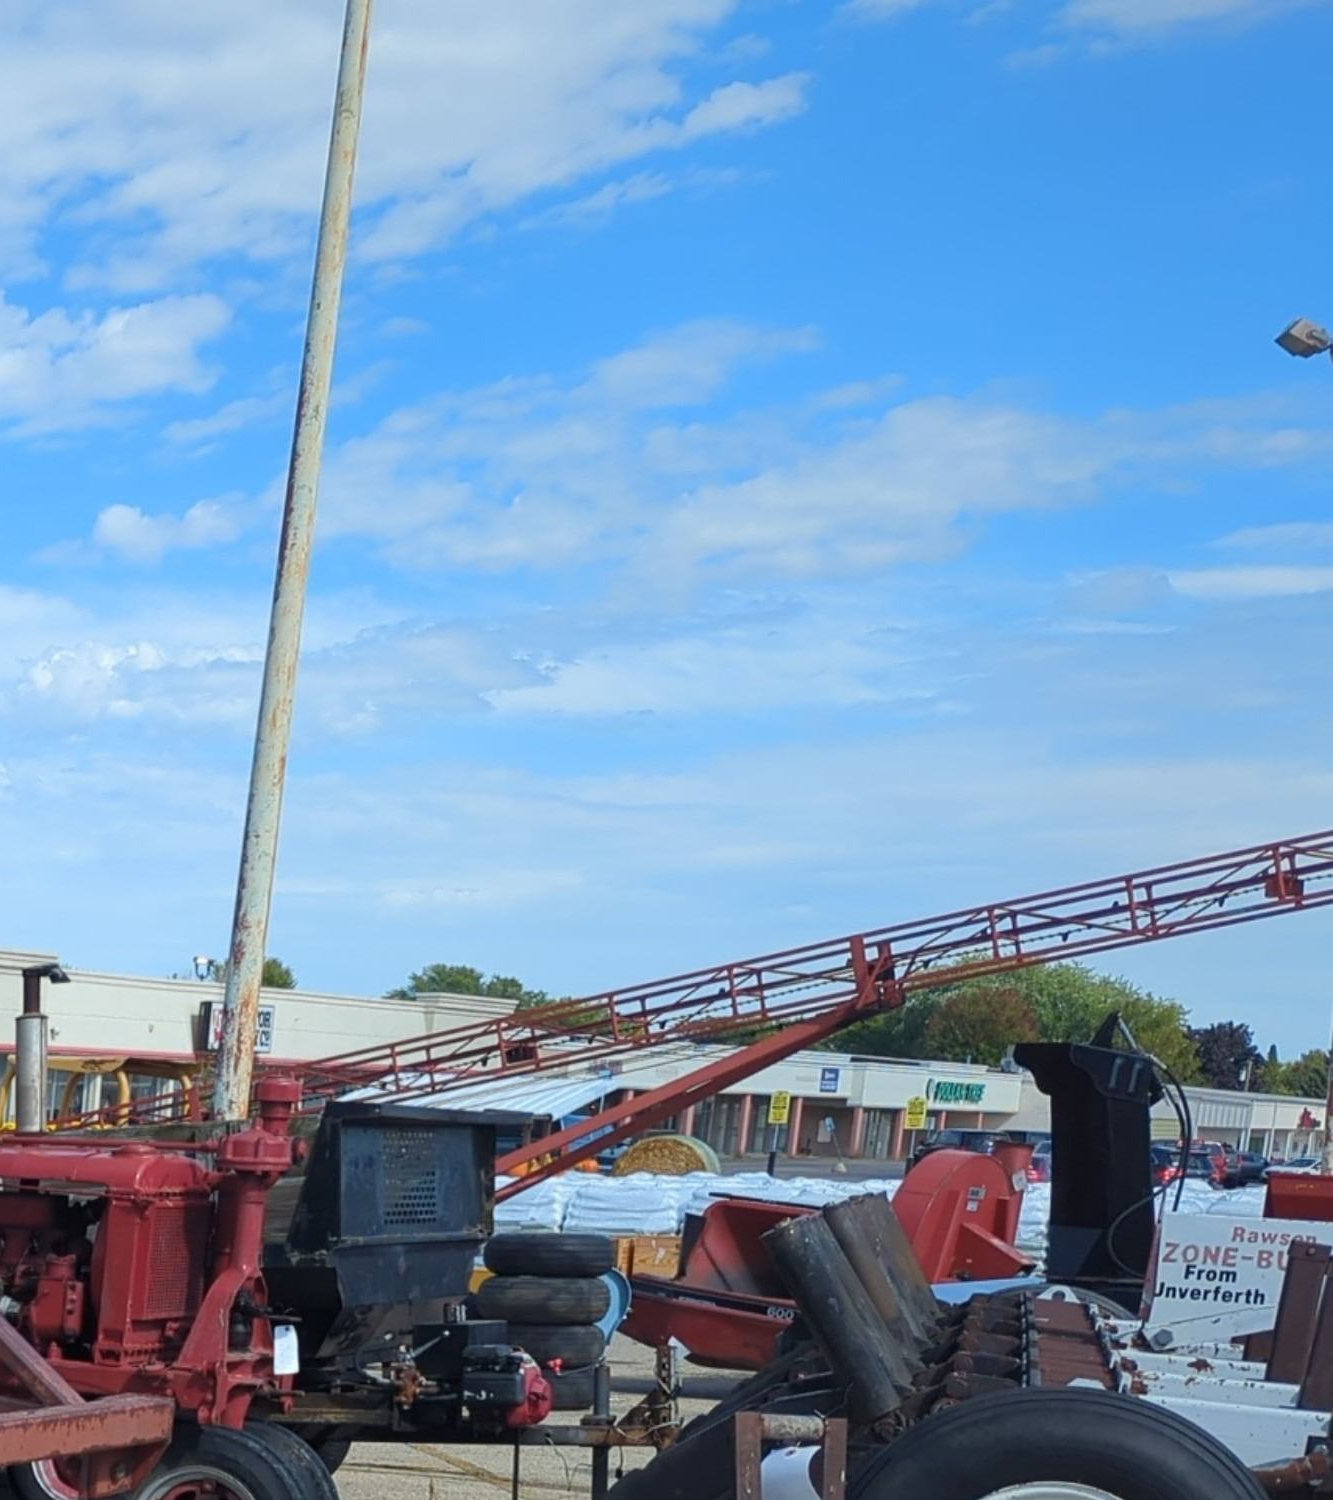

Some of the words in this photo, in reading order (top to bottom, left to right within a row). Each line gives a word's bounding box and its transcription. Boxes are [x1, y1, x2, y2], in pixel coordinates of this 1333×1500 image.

[1161, 1242, 1289, 1272] ZONE-BU
[1184, 1264, 1237, 1283] From
[767, 1307, 794, 1320] 600
